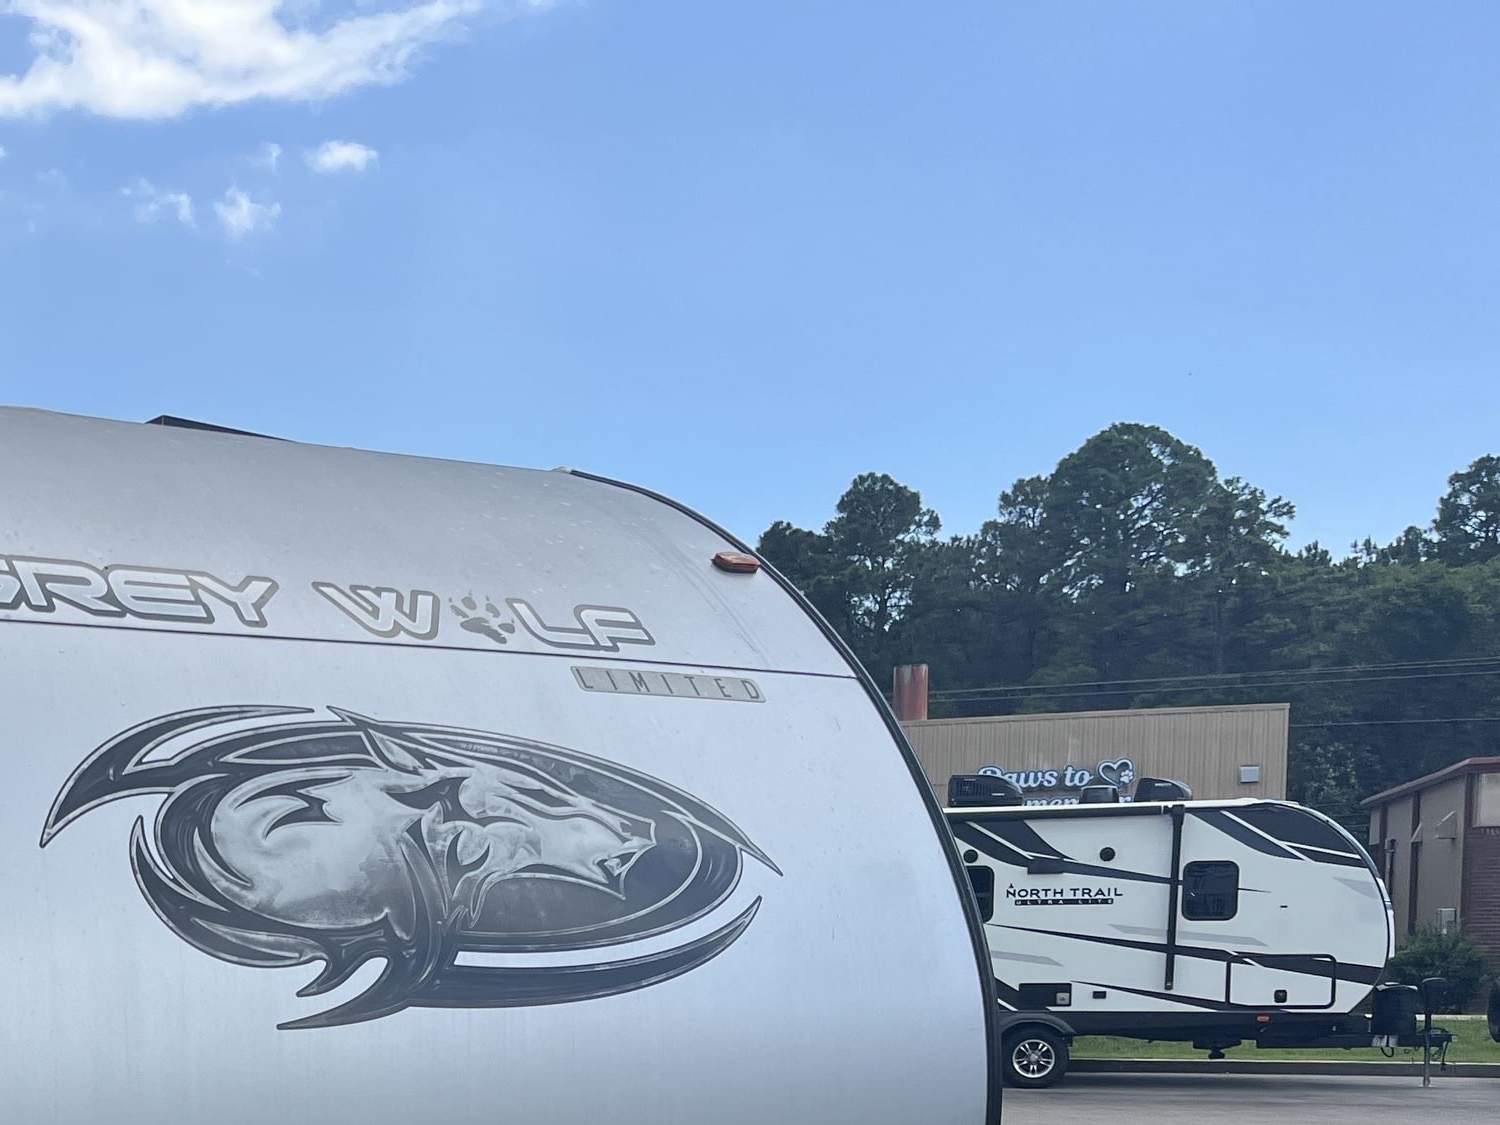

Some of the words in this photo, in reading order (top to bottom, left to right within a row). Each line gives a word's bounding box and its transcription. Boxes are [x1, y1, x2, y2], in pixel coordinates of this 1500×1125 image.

[575, 669, 761, 700] LIMITED
[1063, 764, 1094, 789] to
[1006, 888, 1064, 898] NORTH
[1069, 887, 1124, 897] TRAIL
